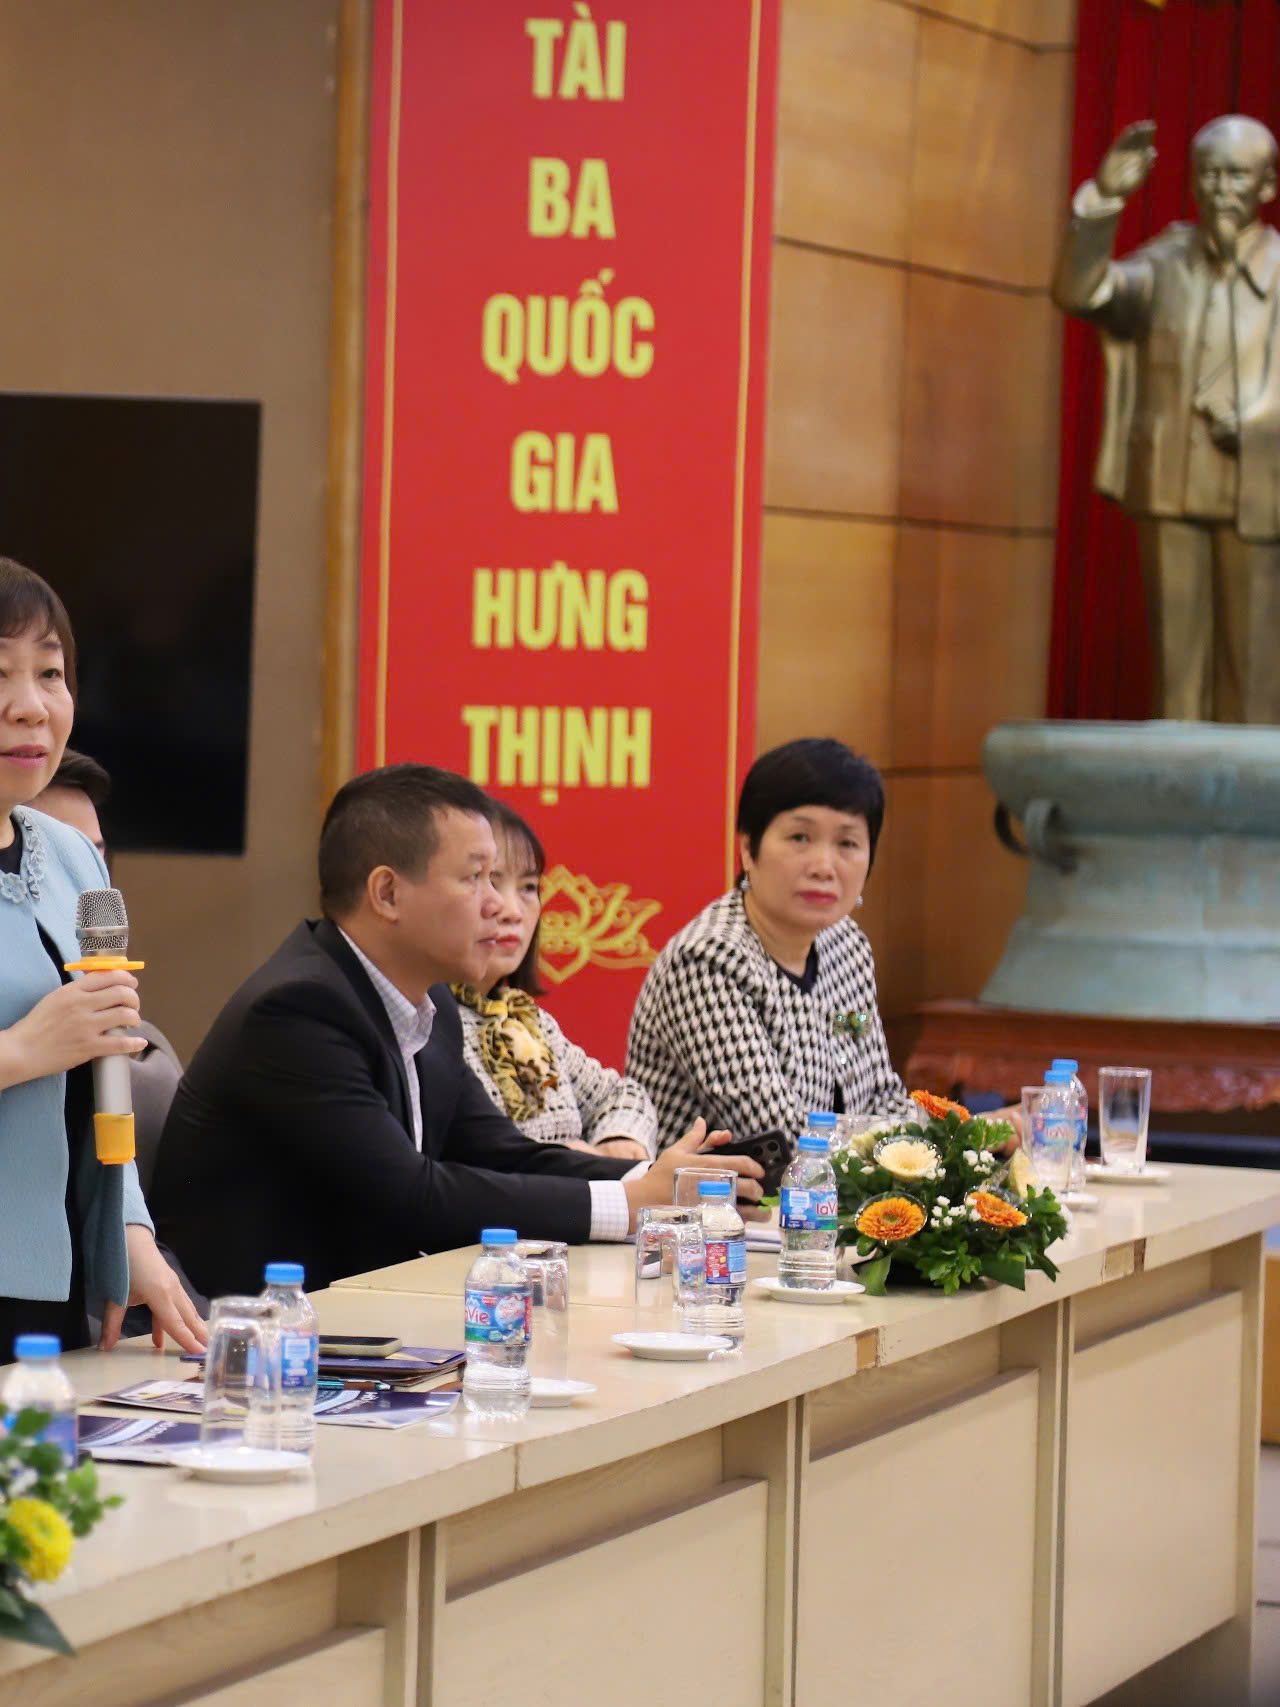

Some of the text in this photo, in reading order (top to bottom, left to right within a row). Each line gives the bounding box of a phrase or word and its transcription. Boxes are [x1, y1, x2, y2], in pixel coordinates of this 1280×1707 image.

[526, 2, 626, 101] TÀI
[529, 157, 616, 239] BA
[482, 268, 655, 384] QUỐC
[511, 431, 619, 513] GIA
[473, 561, 649, 651] HƯNG
[462, 705, 652, 804] THỊNH
